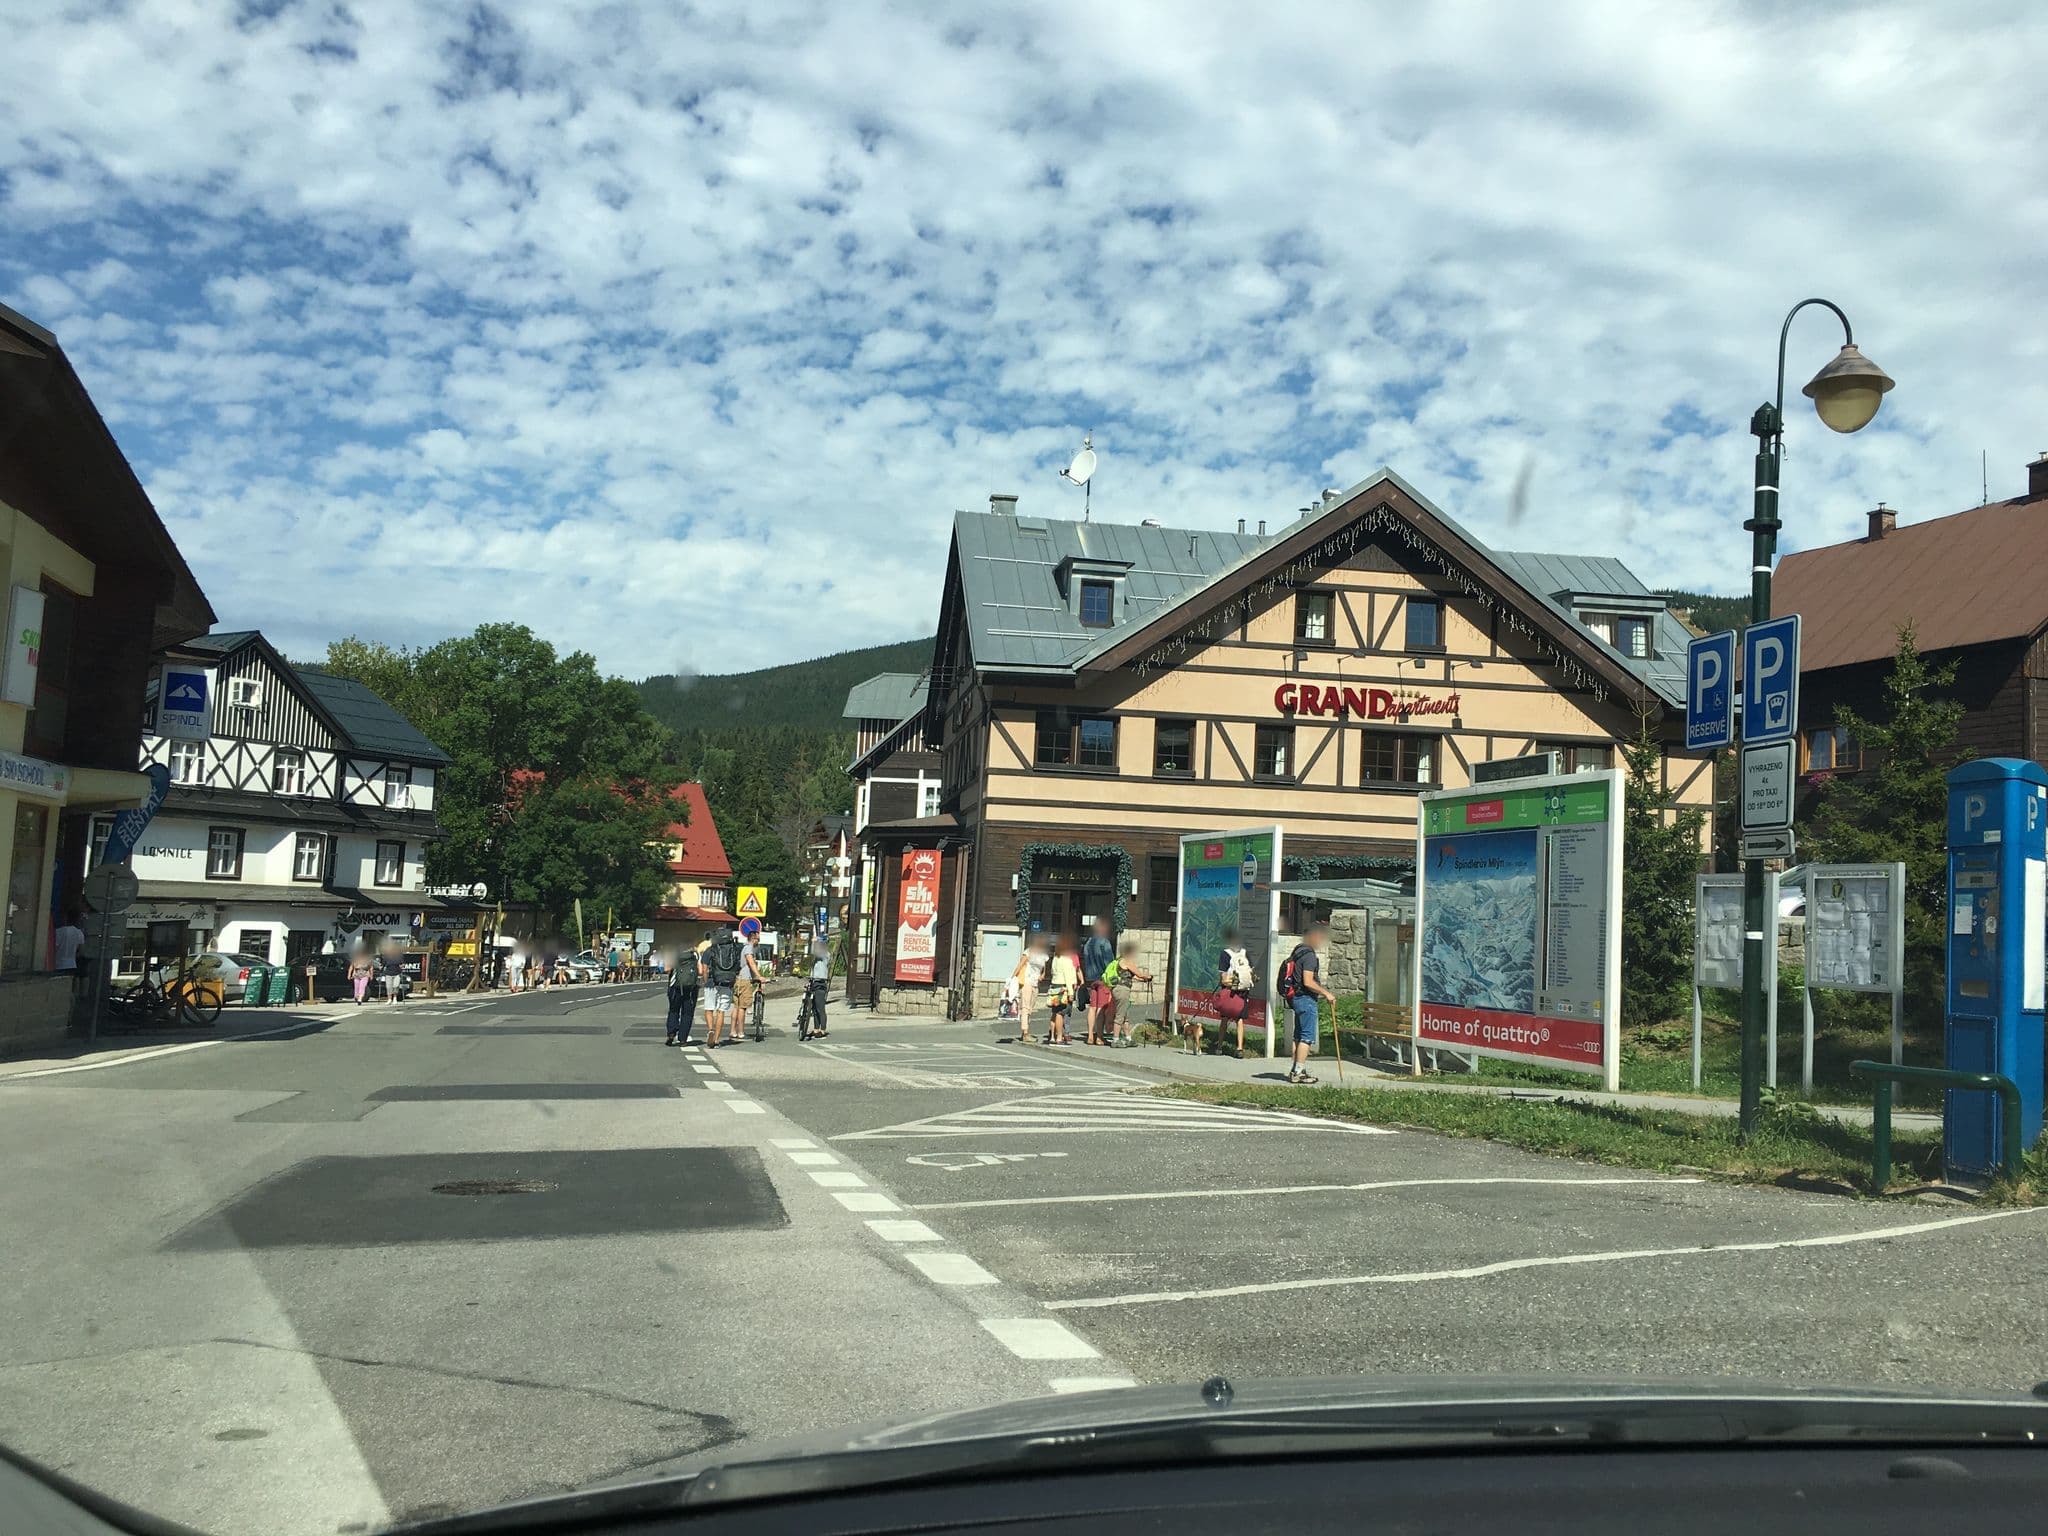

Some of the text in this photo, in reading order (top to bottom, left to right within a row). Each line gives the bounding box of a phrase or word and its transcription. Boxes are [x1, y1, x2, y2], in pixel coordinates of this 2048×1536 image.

[1754, 637, 1784, 705] P
[1696, 650, 1722, 714] P
[1274, 683, 1461, 724] GRAND apartments
[162, 713, 203, 727] SPINDL
[1689, 716, 1726, 738] RÉSERVÉ
[1748, 761, 1783, 774] VYHRAZENO
[1752, 788, 1778, 797] PRO TAXI
[122, 794, 166, 848] RENTAL
[142, 846, 193, 859] LOMNICE
[906, 881, 932, 902] ski
[904, 901, 935, 915] rent
[903, 937, 931, 946] RENTAL
[903, 945, 931, 953] SCHOOL
[1178, 995, 1199, 1009] Home
[1422, 1013, 1461, 1034] Home
[1465, 1020, 1480, 1036] of
